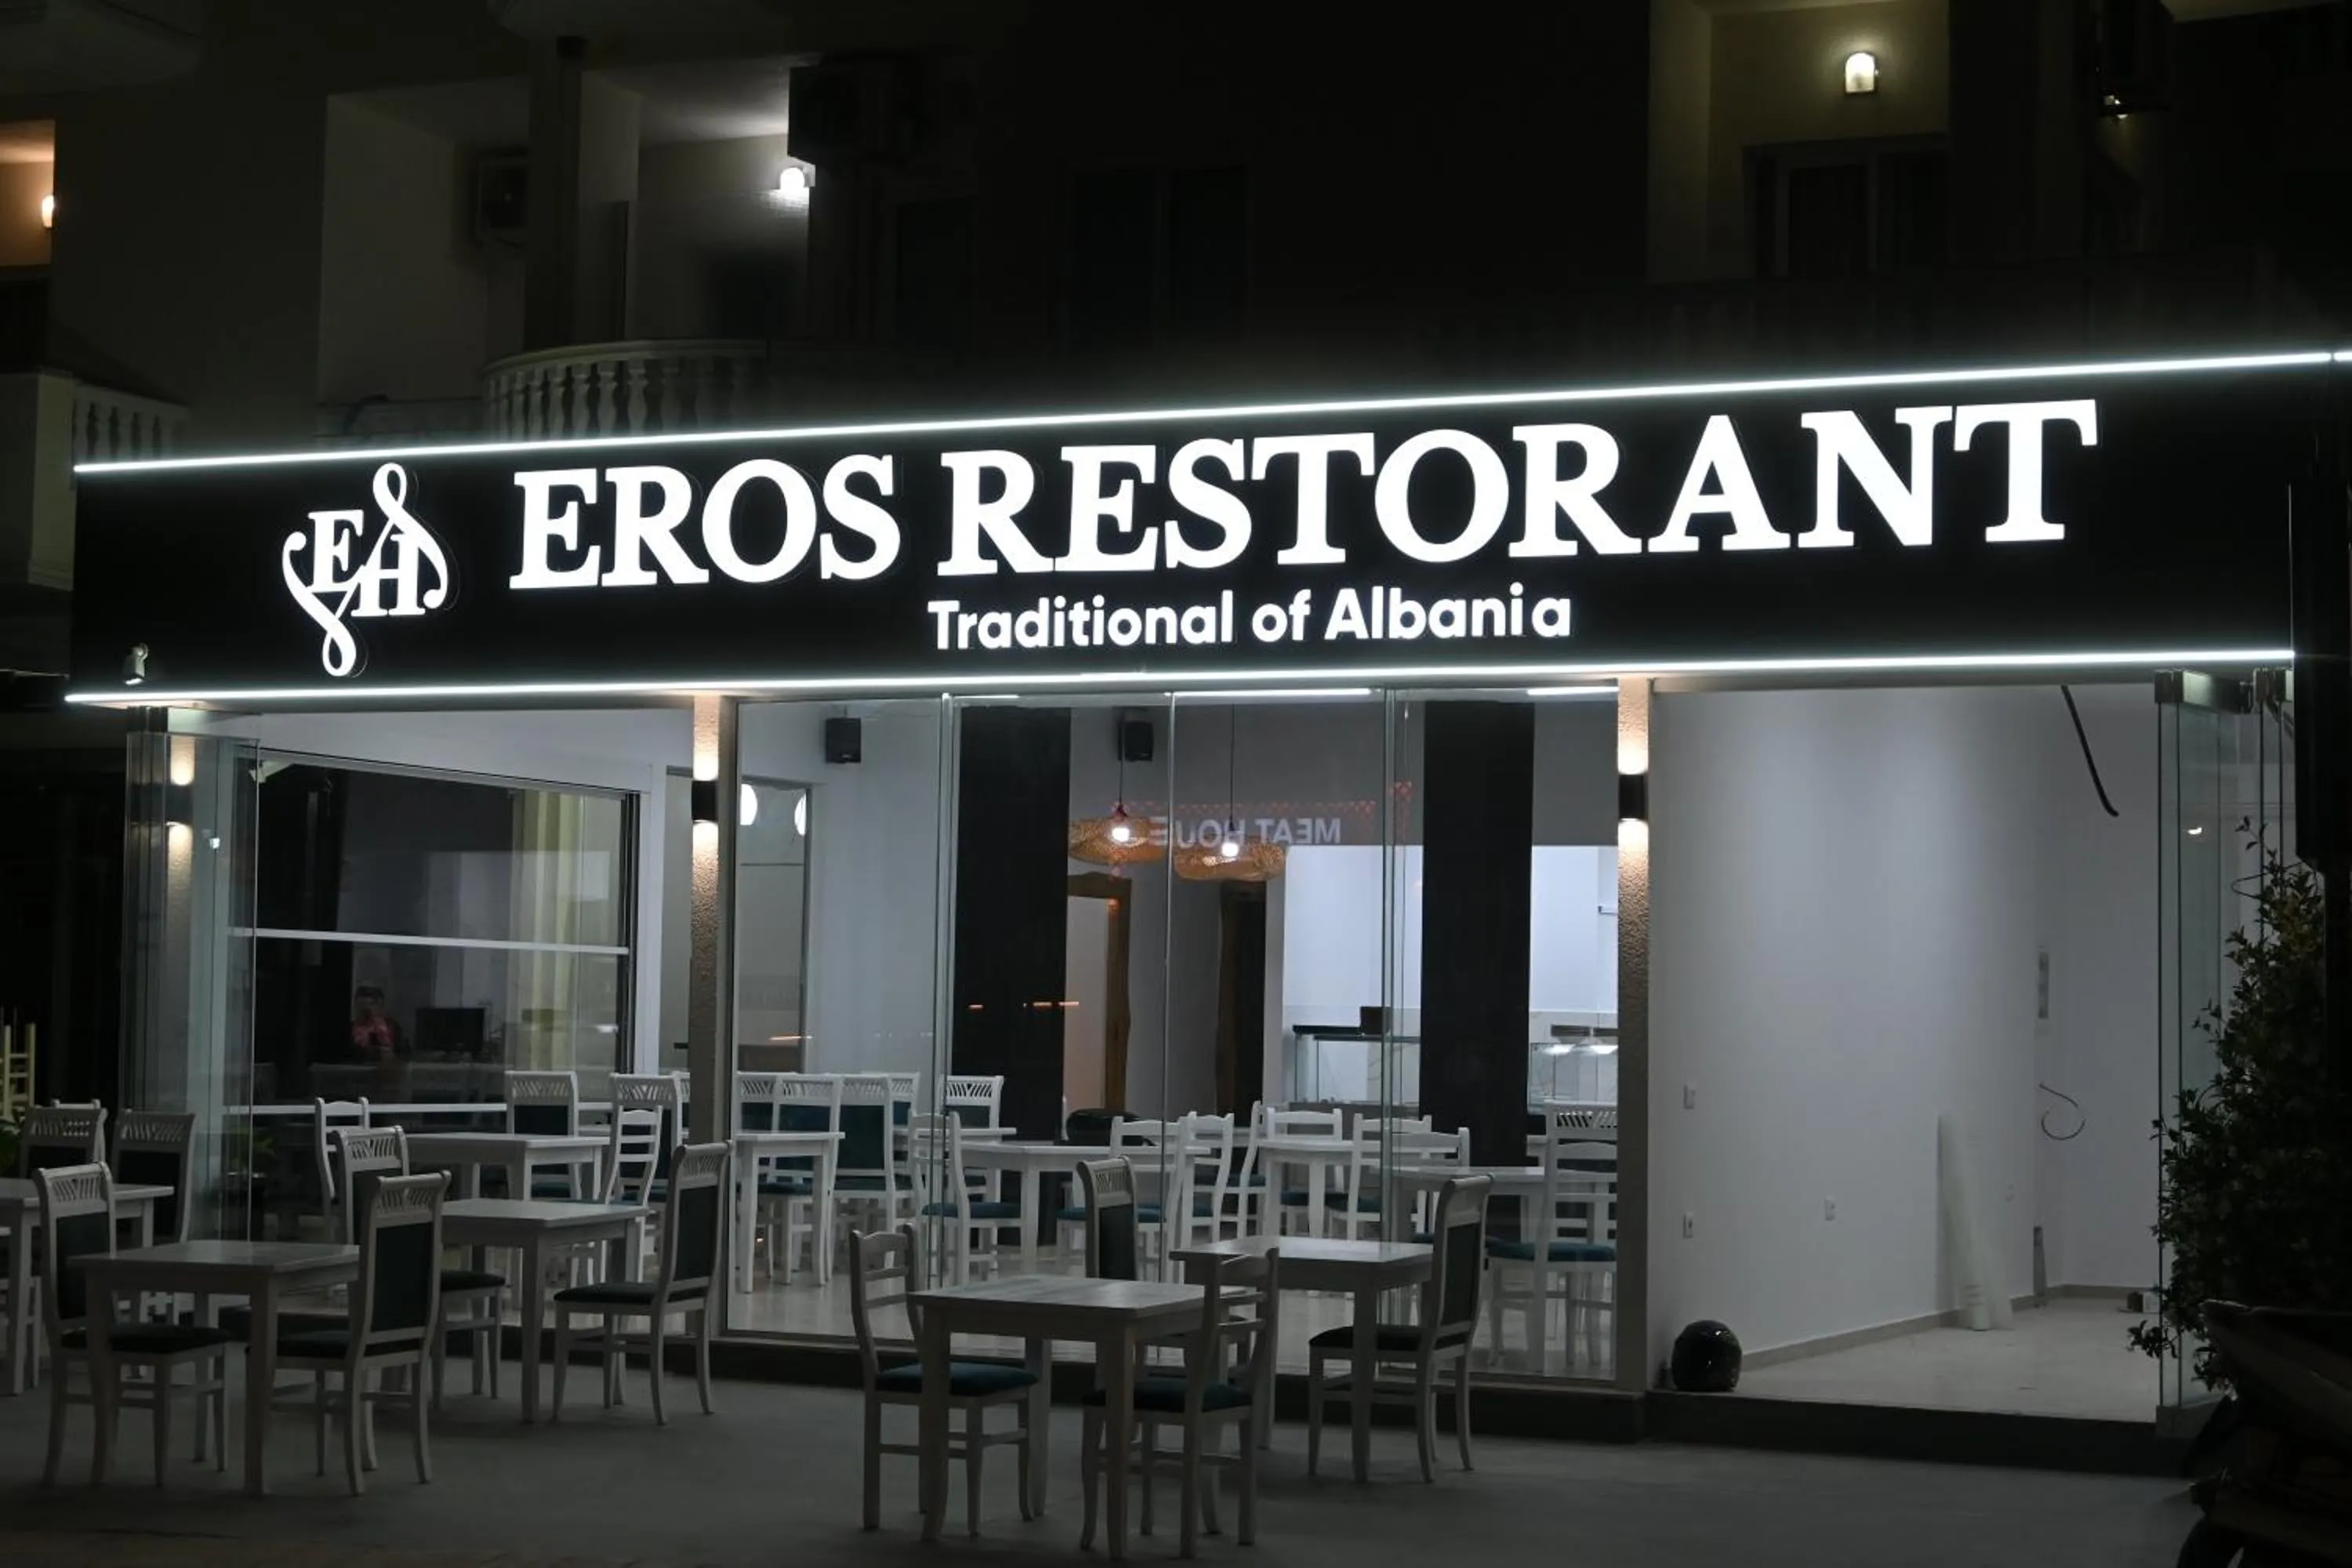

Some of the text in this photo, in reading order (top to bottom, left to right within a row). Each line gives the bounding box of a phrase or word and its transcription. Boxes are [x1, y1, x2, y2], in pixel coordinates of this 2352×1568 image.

[510, 398, 2098, 589] EROS RESTORANT
[927, 582, 1571, 650] Traditional of Albania
